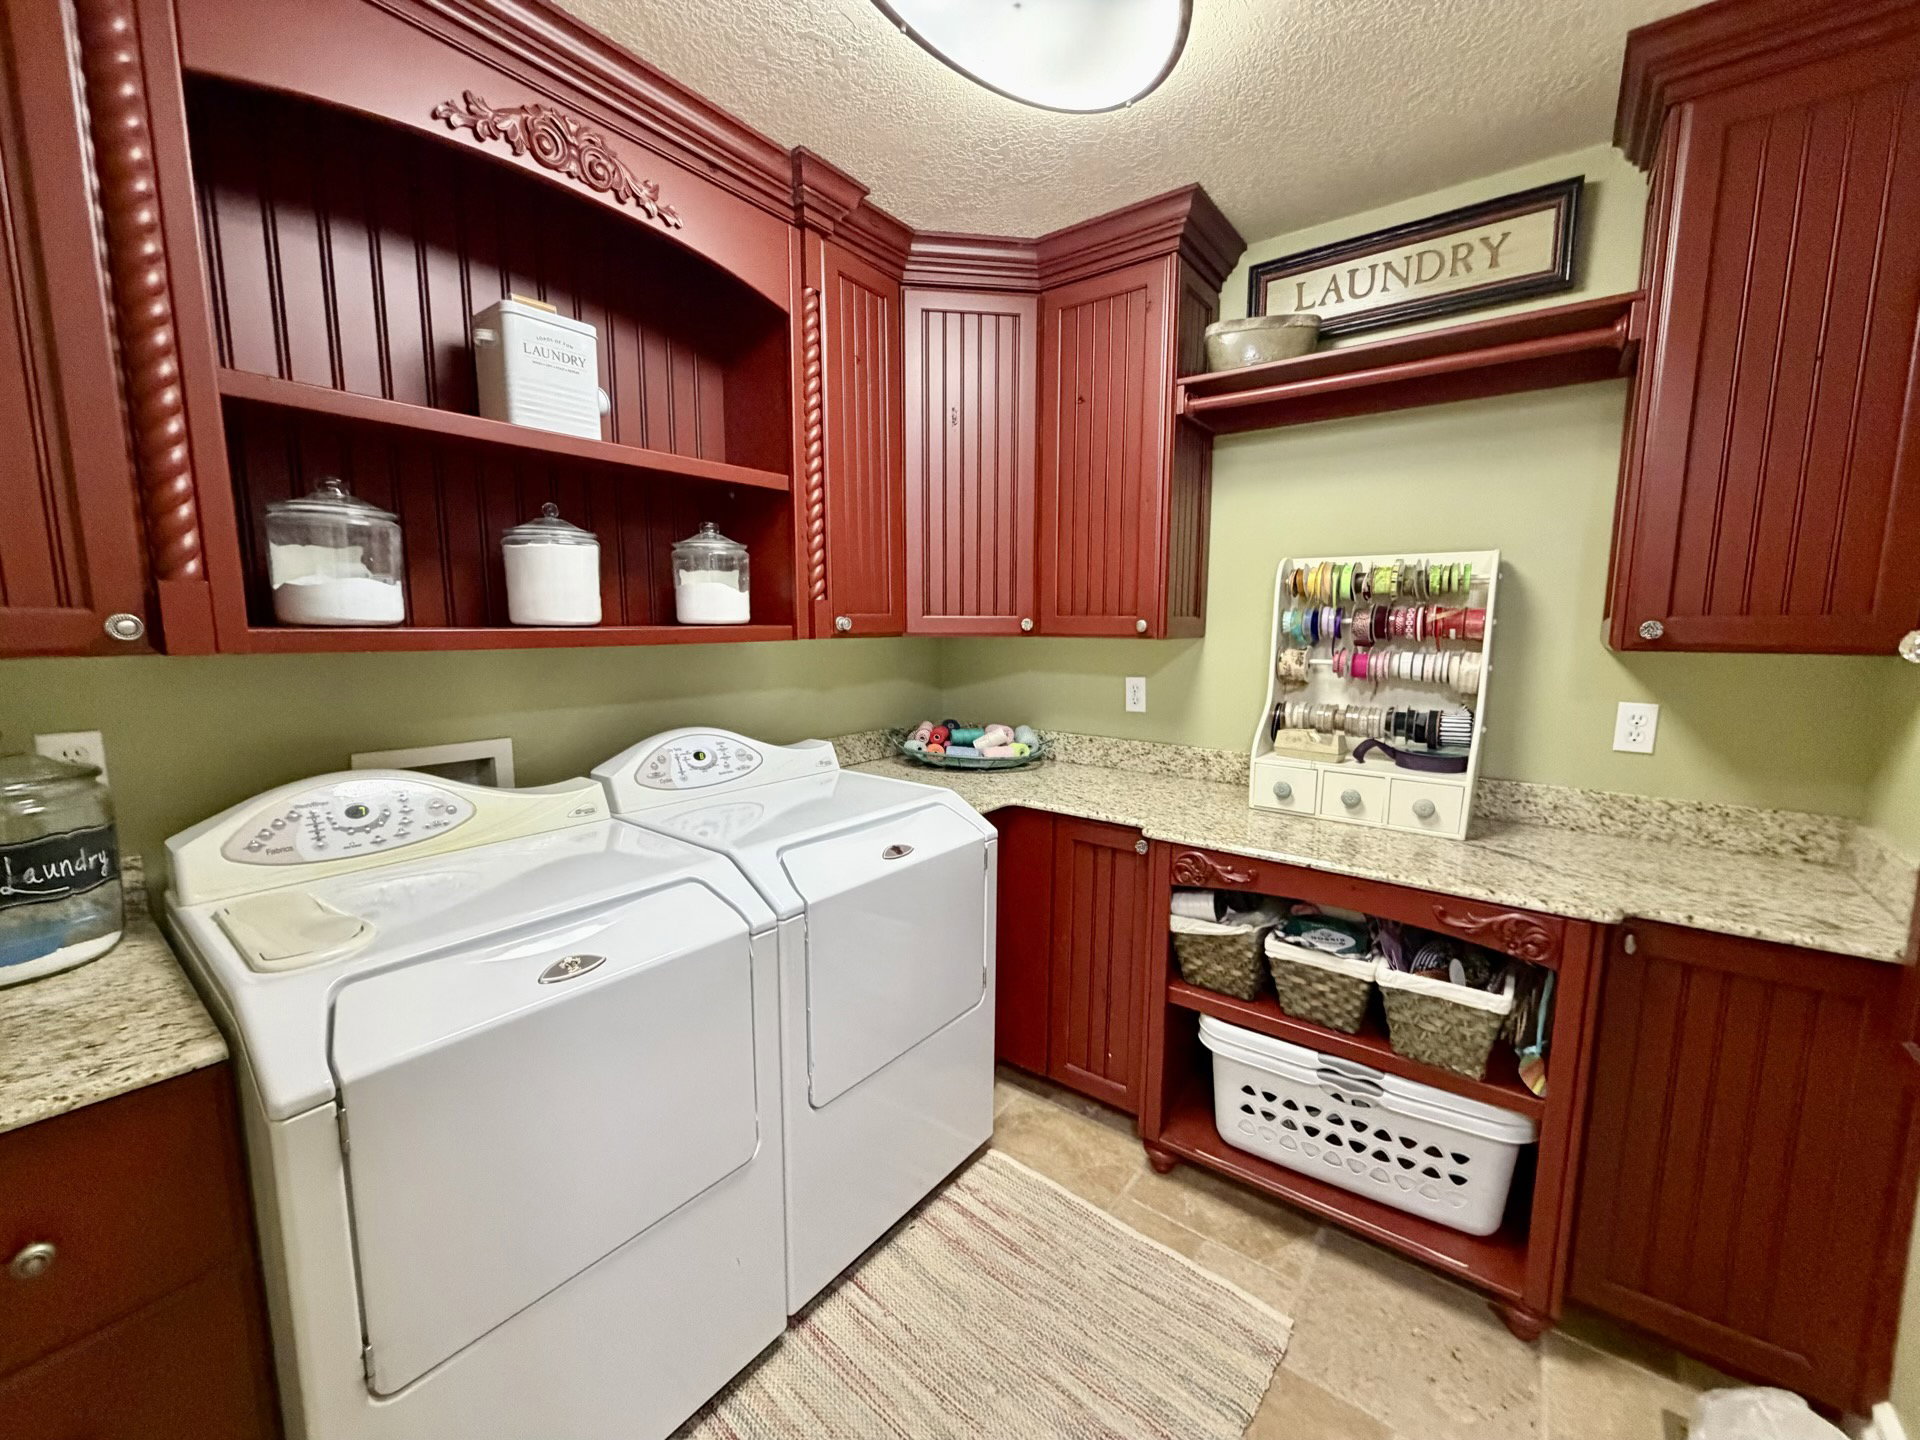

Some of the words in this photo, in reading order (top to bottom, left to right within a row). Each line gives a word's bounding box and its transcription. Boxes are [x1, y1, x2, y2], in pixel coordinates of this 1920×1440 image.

[1294, 231, 1512, 312] LAUNDRY
[523, 342, 587, 369] LAUNDRY
[1, 848, 110, 895] Laundry
